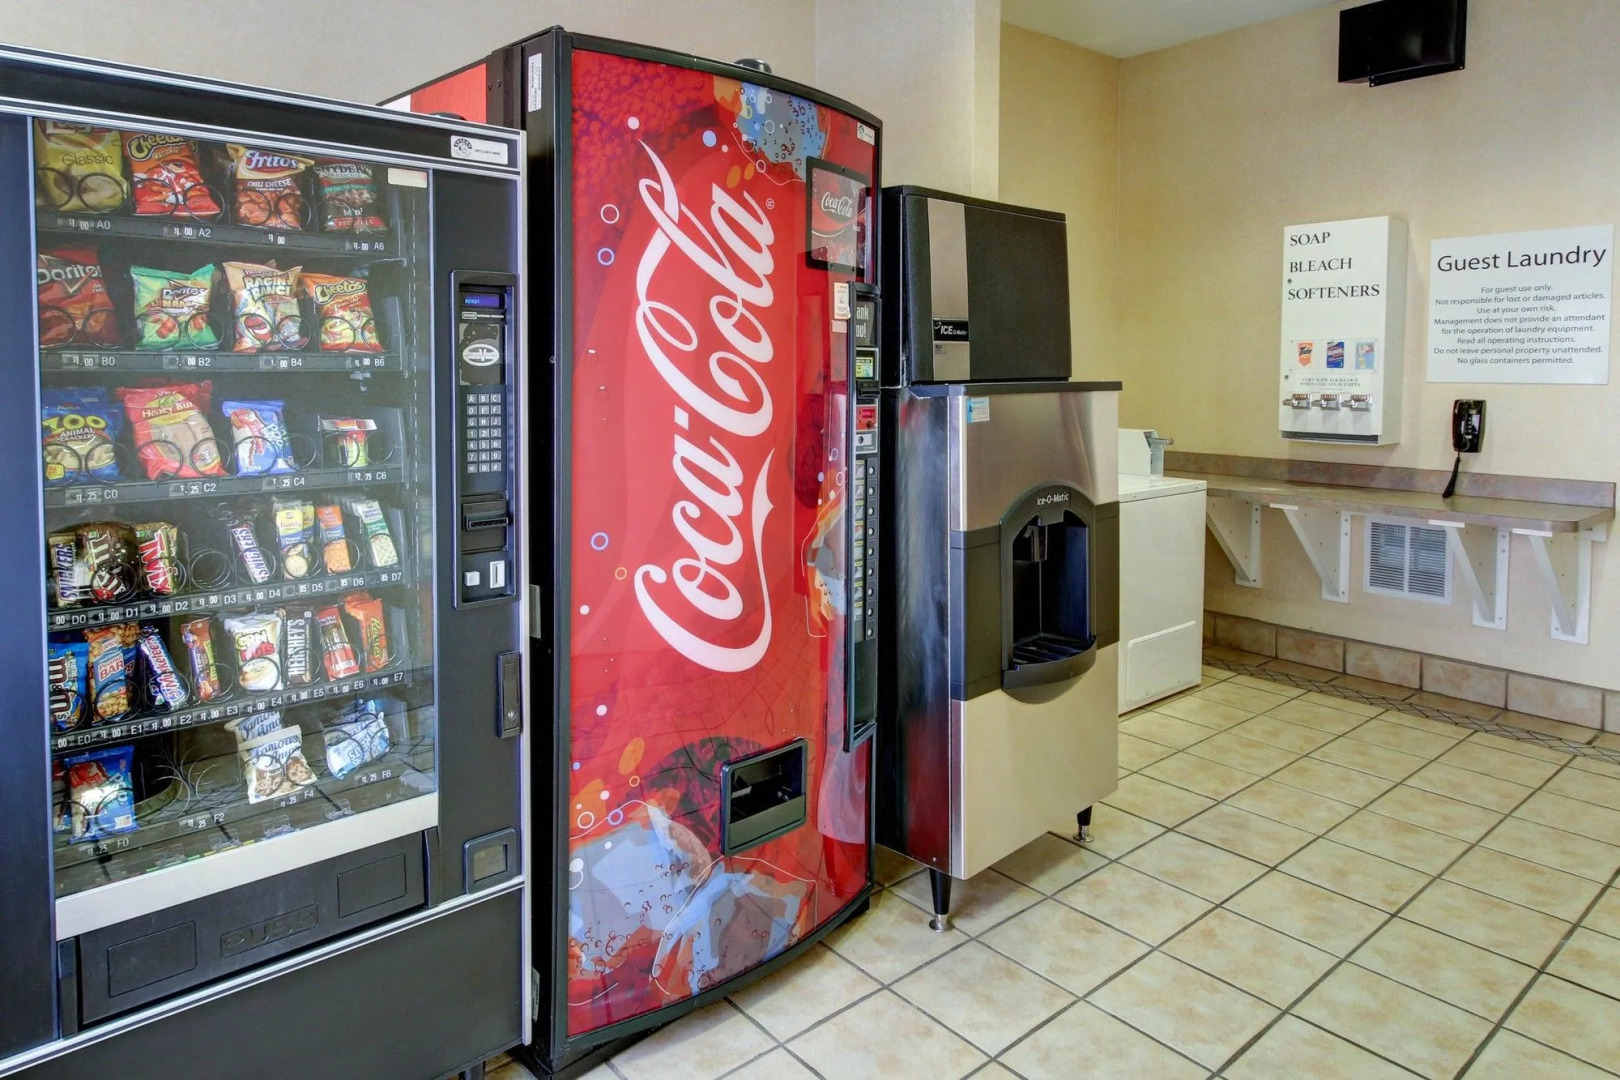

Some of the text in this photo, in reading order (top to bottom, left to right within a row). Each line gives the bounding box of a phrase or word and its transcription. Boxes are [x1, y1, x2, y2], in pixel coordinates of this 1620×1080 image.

[62, 153, 114, 166] Classic
[245, 150, 299, 169] Fritos
[266, 178, 292, 188] CHEESE
[821, 192, 854, 218] Coca-Cola
[96, 220, 111, 230] A0
[198, 228, 211, 238] A2
[1290, 232, 1330, 246] SOAP
[374, 242, 384, 250] A6
[1437, 246, 1606, 272] Guest Laundry
[1290, 258, 1352, 273] BLEACH
[162, 287, 206, 300] Doritos
[315, 280, 363, 302] Cheetos
[1288, 284, 1380, 300] SOFTENERS
[1495, 286, 1516, 294] guest
[1450, 296, 1492, 306] responsible
[1532, 294, 1571, 302] damaged
[1573, 292, 1606, 300] articles.
[1502, 308, 1518, 316] your
[1434, 318, 1482, 326] Management
[1519, 315, 1550, 324] provide
[1564, 314, 1605, 322] attendant
[940, 326, 953, 335] ICE
[1467, 327, 1503, 335] operation
[1515, 326, 1545, 334] laundry
[1547, 325, 1595, 334] equipment.
[1487, 337, 1525, 345] operating
[1299, 346, 1312, 356] Tide
[1481, 347, 1514, 355] personal
[1516, 347, 1550, 355] property
[102, 356, 115, 366] B0
[198, 357, 210, 366] B2
[291, 358, 302, 367] B4
[374, 358, 384, 366] B6
[1532, 357, 1574, 365] permitted.
[634, 139, 775, 673] Coca-Cola
[142, 406, 173, 418] Honey
[60, 427, 94, 437] ANIMAL
[376, 472, 386, 480] C6
[294, 477, 305, 486] C4
[204, 483, 216, 492] C2
[104, 490, 118, 500] C0
[1037, 492, 1069, 506] Ice-O-Matic
[56, 542, 78, 600] SNICKERS
[392, 572, 402, 581] D7
[353, 577, 364, 586] D6
[312, 583, 323, 592] D5
[269, 589, 280, 598] D4
[224, 595, 236, 604] D3
[175, 601, 188, 610] D2
[126, 608, 139, 617] D1
[72, 614, 86, 624] D0
[100, 659, 125, 680] BAR
[394, 673, 403, 682] E7
[354, 681, 364, 690] E6
[314, 688, 324, 697] E5
[271, 697, 282, 706] E4
[227, 706, 238, 715] E3
[180, 716, 192, 725] E2
[131, 724, 142, 734] E1
[78, 735, 90, 744] E0
[382, 770, 391, 779] F6
[304, 790, 314, 799] F4
[214, 813, 224, 822] F2
[117, 839, 129, 848] F0
